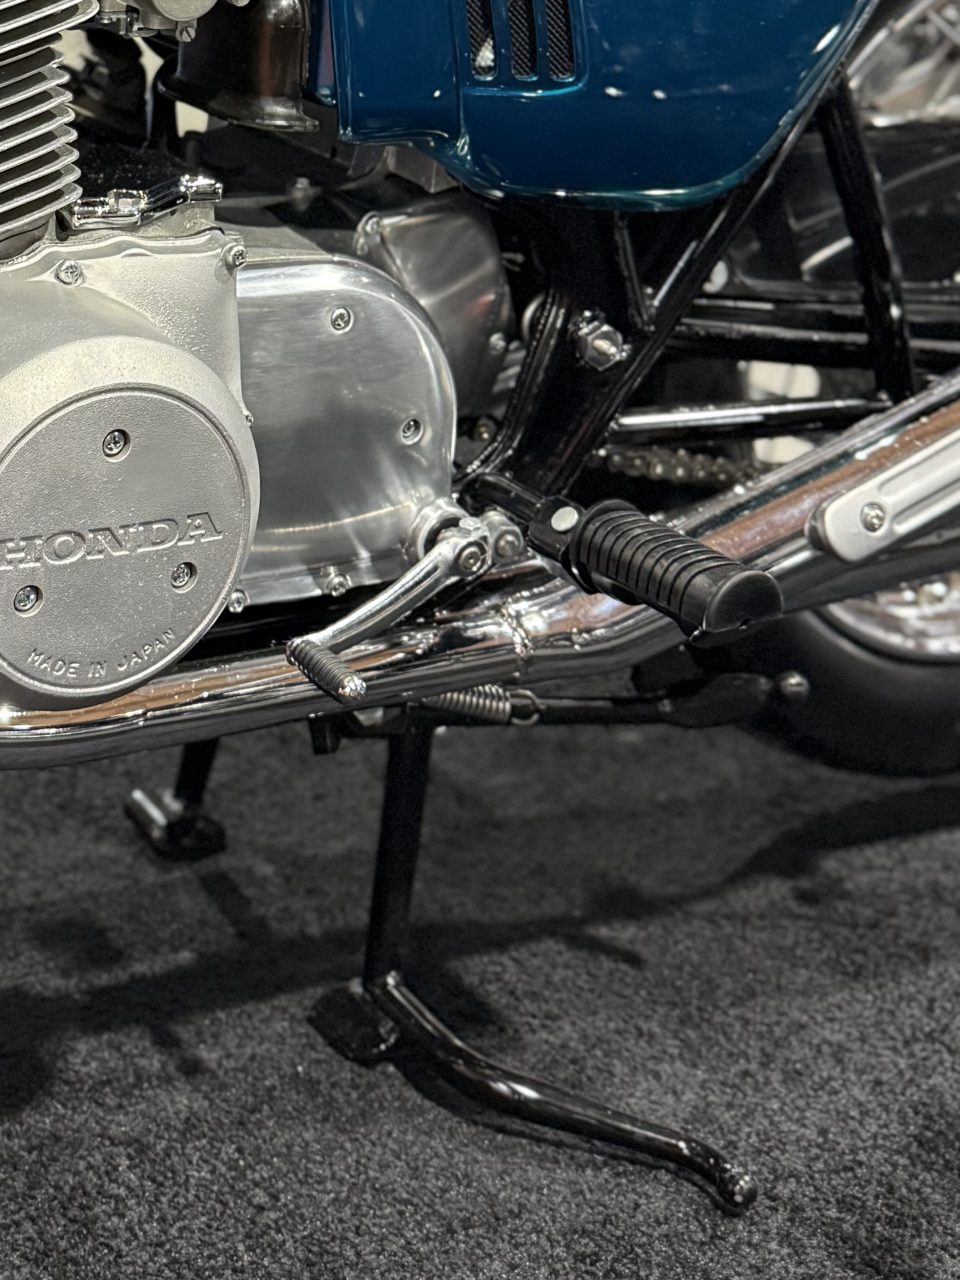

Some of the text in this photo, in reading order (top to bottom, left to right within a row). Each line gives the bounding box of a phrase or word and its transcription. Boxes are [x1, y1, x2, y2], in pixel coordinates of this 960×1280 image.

[27, 627, 176, 677] MADE IN JAPAN
